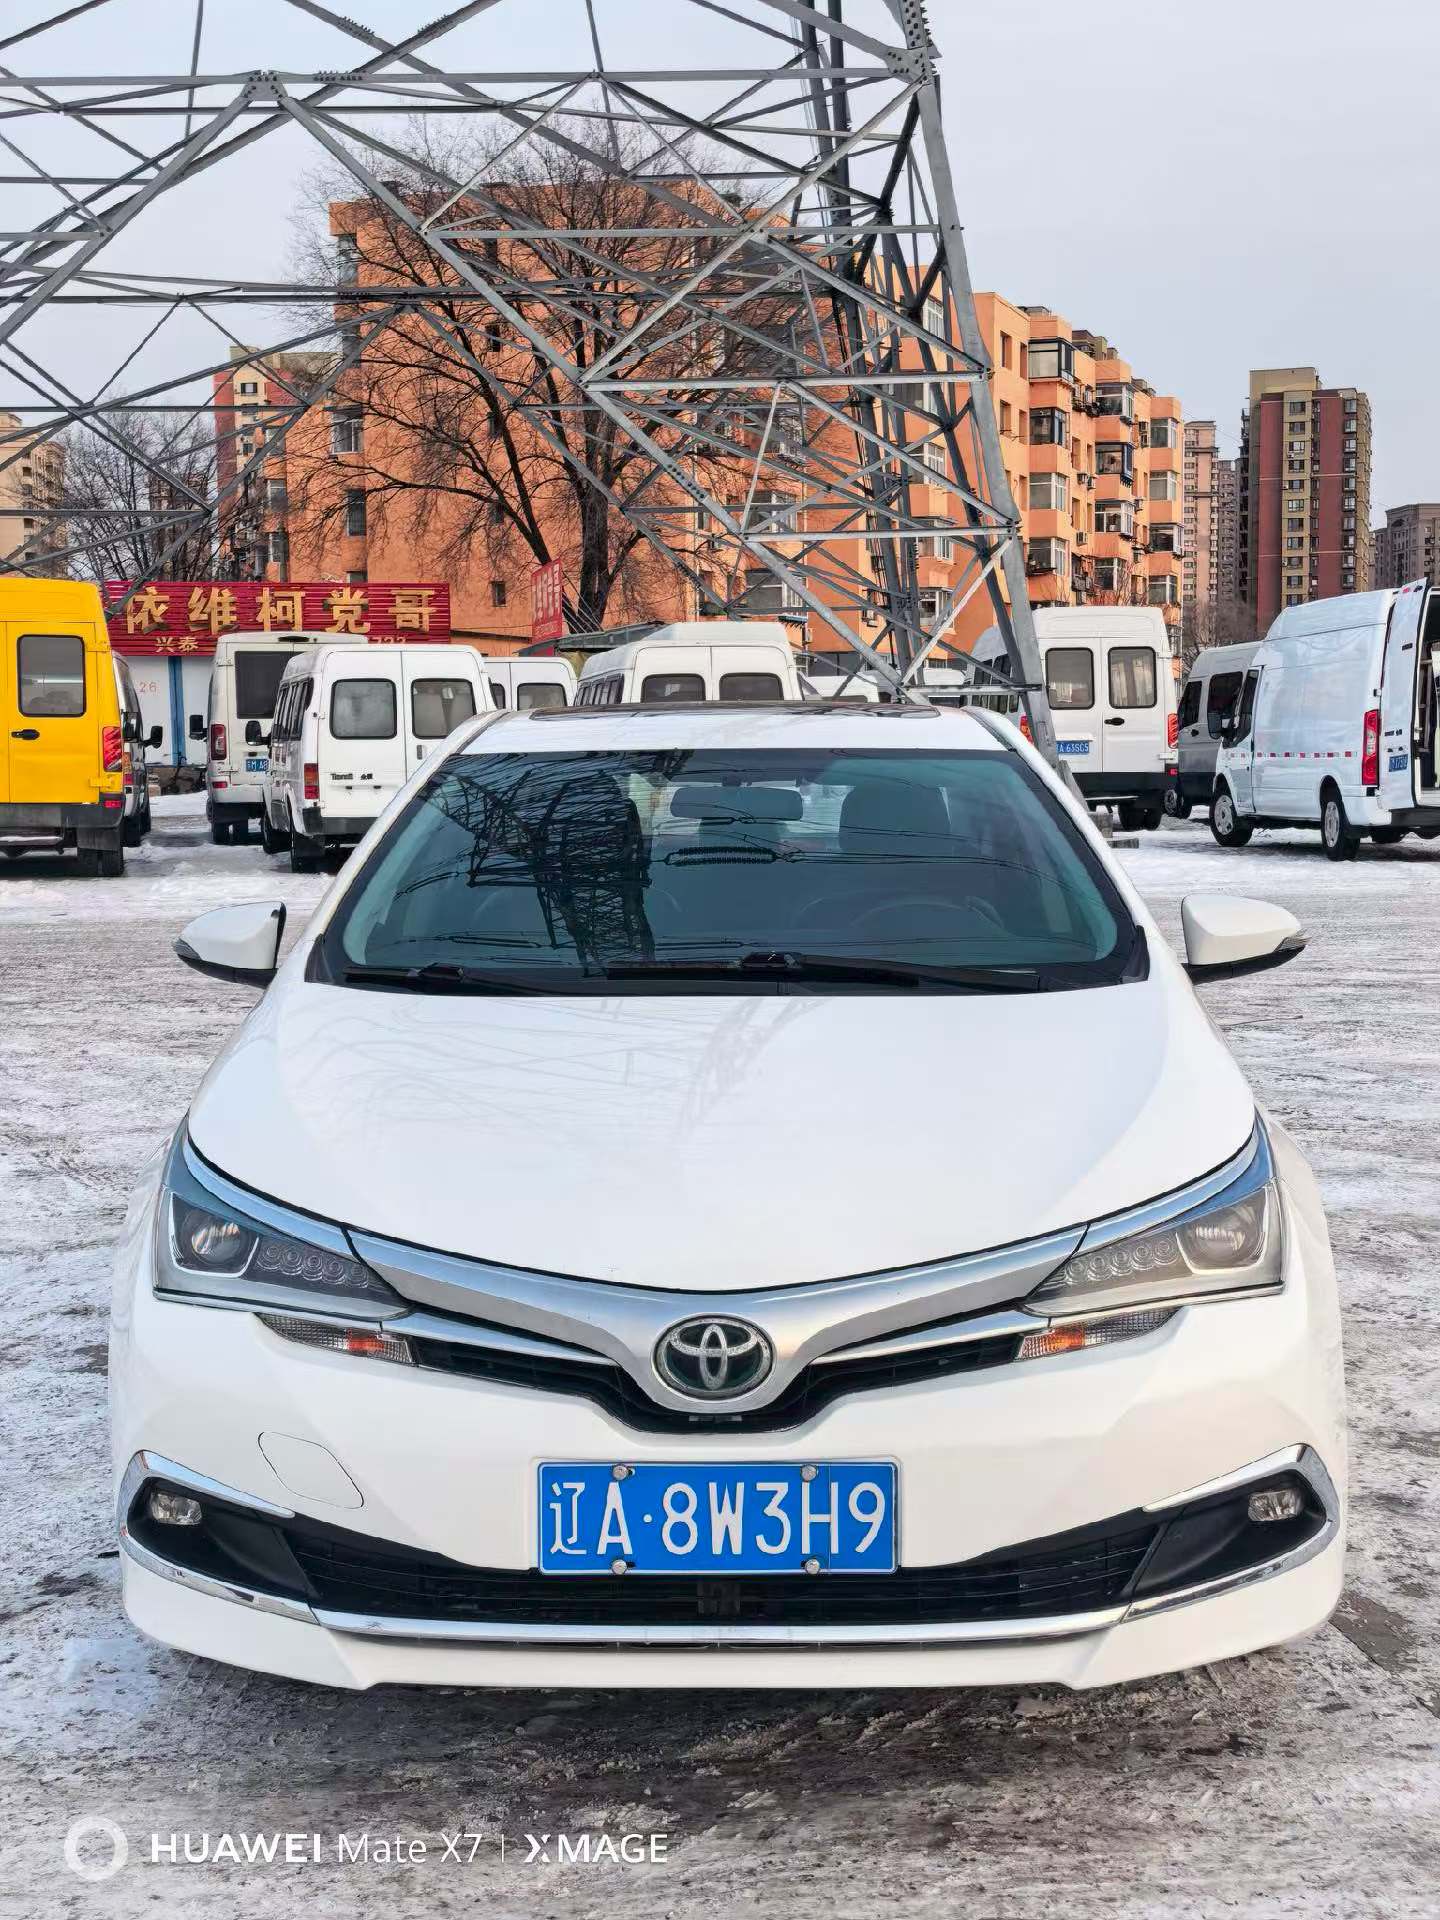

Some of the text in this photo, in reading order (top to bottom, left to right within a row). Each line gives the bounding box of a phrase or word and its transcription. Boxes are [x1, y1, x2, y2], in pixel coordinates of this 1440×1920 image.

[127, 586, 438, 634] 依维柯党哥
[155, 636, 199, 652] 兴泰
[550, 1482, 886, 1555] 辽A·8W3H9
